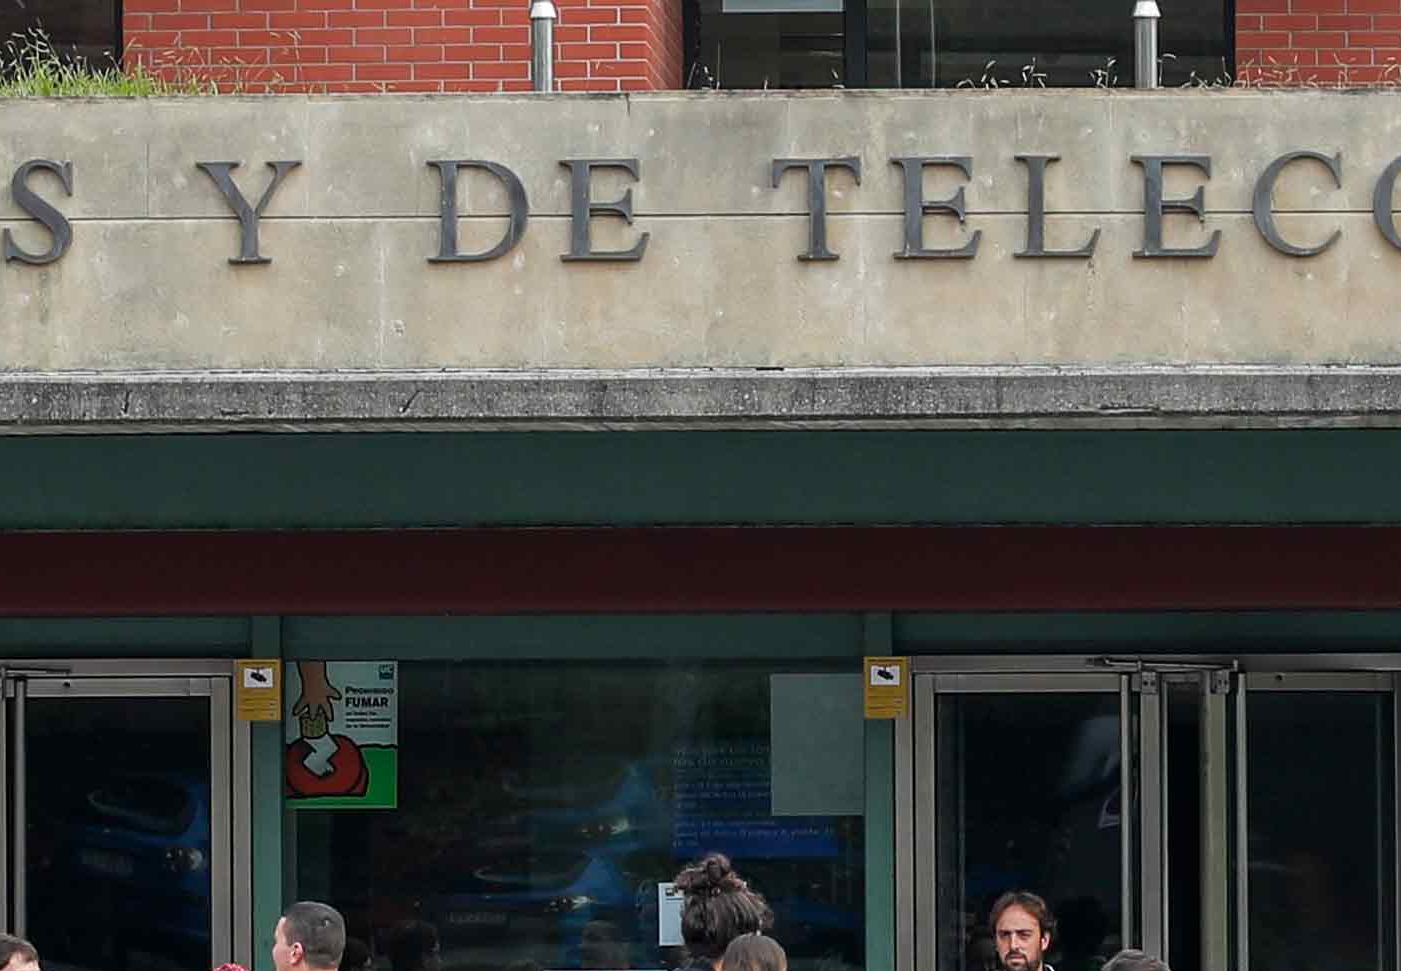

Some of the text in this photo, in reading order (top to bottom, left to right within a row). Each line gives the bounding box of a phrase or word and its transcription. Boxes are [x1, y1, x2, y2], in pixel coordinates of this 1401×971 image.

[196, 159, 302, 264] Y
[426, 157, 650, 262] DE
[345, 697, 389, 708] FUMAR
